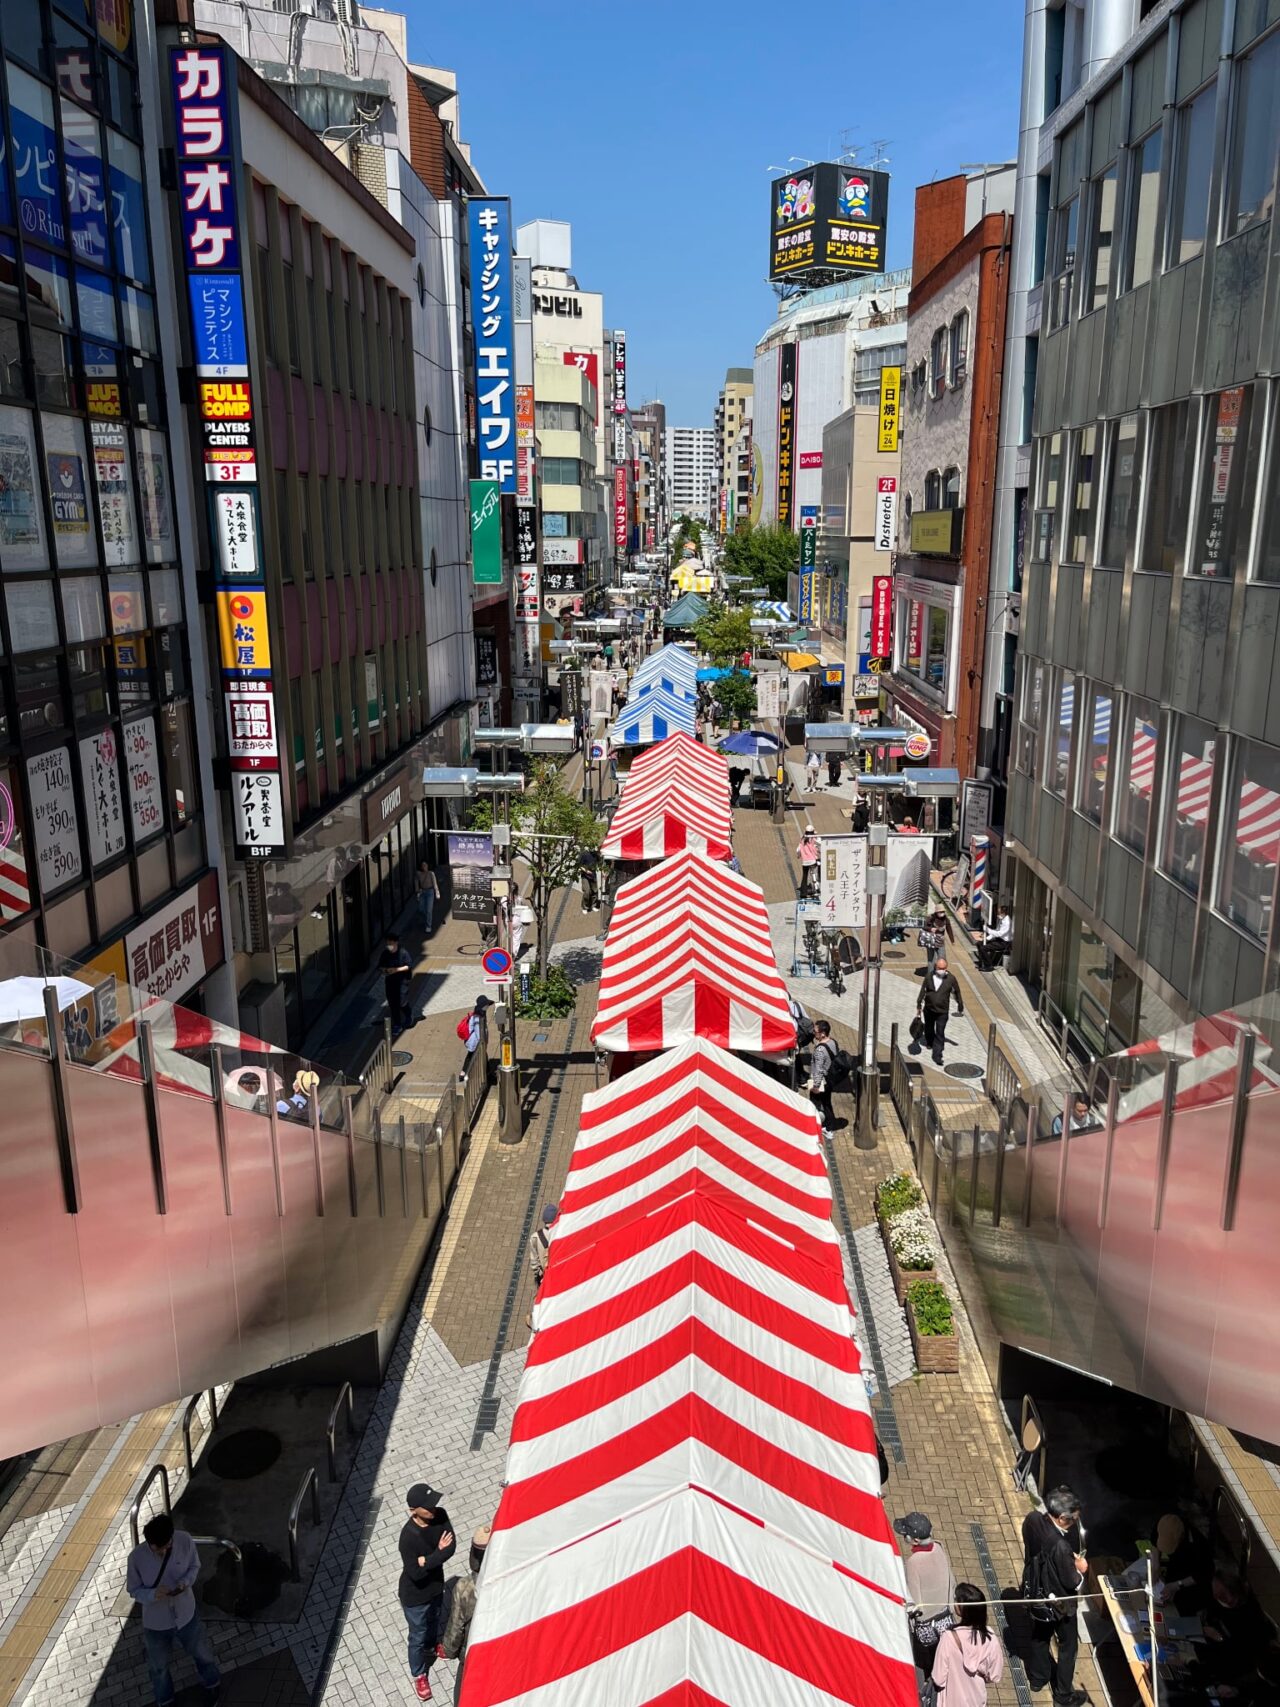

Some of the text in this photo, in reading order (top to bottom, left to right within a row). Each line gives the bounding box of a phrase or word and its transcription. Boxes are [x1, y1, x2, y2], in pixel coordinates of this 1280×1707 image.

[176, 50, 234, 267] カラオケ
[478, 208, 502, 338] キャッシング
[217, 289, 233, 332] マシン
[202, 288, 220, 360] ピラティス
[215, 366, 229, 375] 4F
[201, 383, 248, 401] FULL
[478, 347, 511, 450] エイワ
[202, 402, 251, 417] COMP
[883, 388, 896, 431] 日焼け
[204, 422, 251, 433] PLAYERS
[208, 435, 249, 446] CENTER
[883, 437, 893, 445] 24
[220, 465, 241, 480] 3F
[481, 459, 513, 483] 5F
[801, 456, 821, 465] DAISO
[881, 479, 894, 491] 2F
[54, 500, 79, 519] GYM
[471, 487, 499, 531] エイブル
[235, 500, 248, 543] 大衆食堂
[616, 505, 626, 543] カラオケ
[226, 509, 238, 569] てんぐ大ホール
[804, 528, 814, 566] バーミヤン
[520, 554, 532, 562] 2F
[877, 590, 886, 655] BURGER KING
[234, 623, 255, 665] 松屋
[229, 682, 267, 691] 即日現金
[233, 703, 267, 721] 高価
[235, 721, 269, 738] 買取
[232, 740, 273, 750] おたからや
[907, 743, 928, 752] KING
[240, 776, 259, 842] ルノアール
[260, 789, 272, 828] 喫茶室
[251, 847, 272, 857] B1F
[453, 893, 492, 902] ルネタワー
[839, 870, 850, 901] 八王子
[851, 848, 861, 923] ザ・ファインタワー
[459, 902, 487, 910] 八王子
[202, 905, 217, 936] 1F
[131, 905, 197, 986] 高価買取
